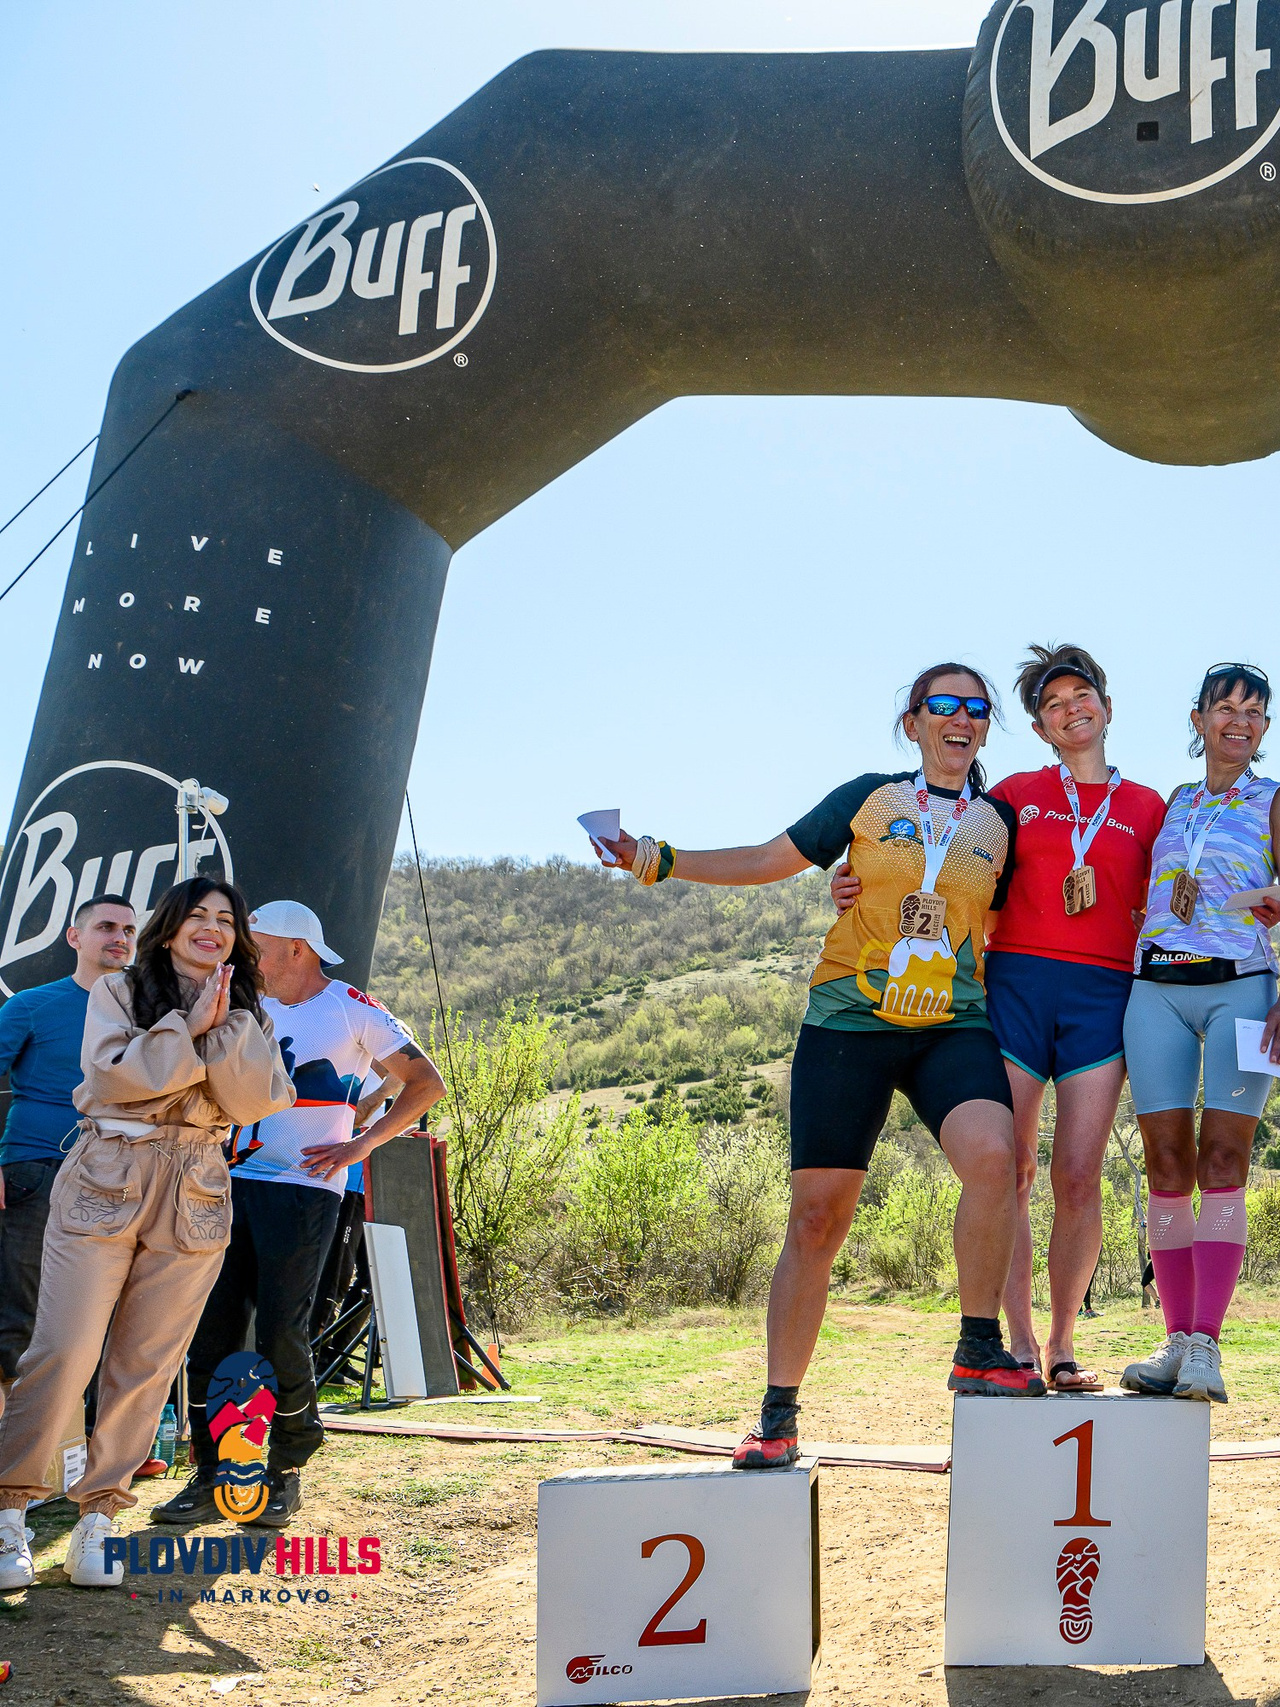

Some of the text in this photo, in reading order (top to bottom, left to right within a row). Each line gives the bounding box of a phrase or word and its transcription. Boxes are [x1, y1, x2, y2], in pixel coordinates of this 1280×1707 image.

[85, 533, 284, 566] LIVE
[87, 653, 205, 675] NOW
[1106, 818, 1135, 836] Bank
[916, 912, 932, 935] 2
[1052, 1419, 1111, 1527] 1
[637, 1533, 707, 1648] 2
